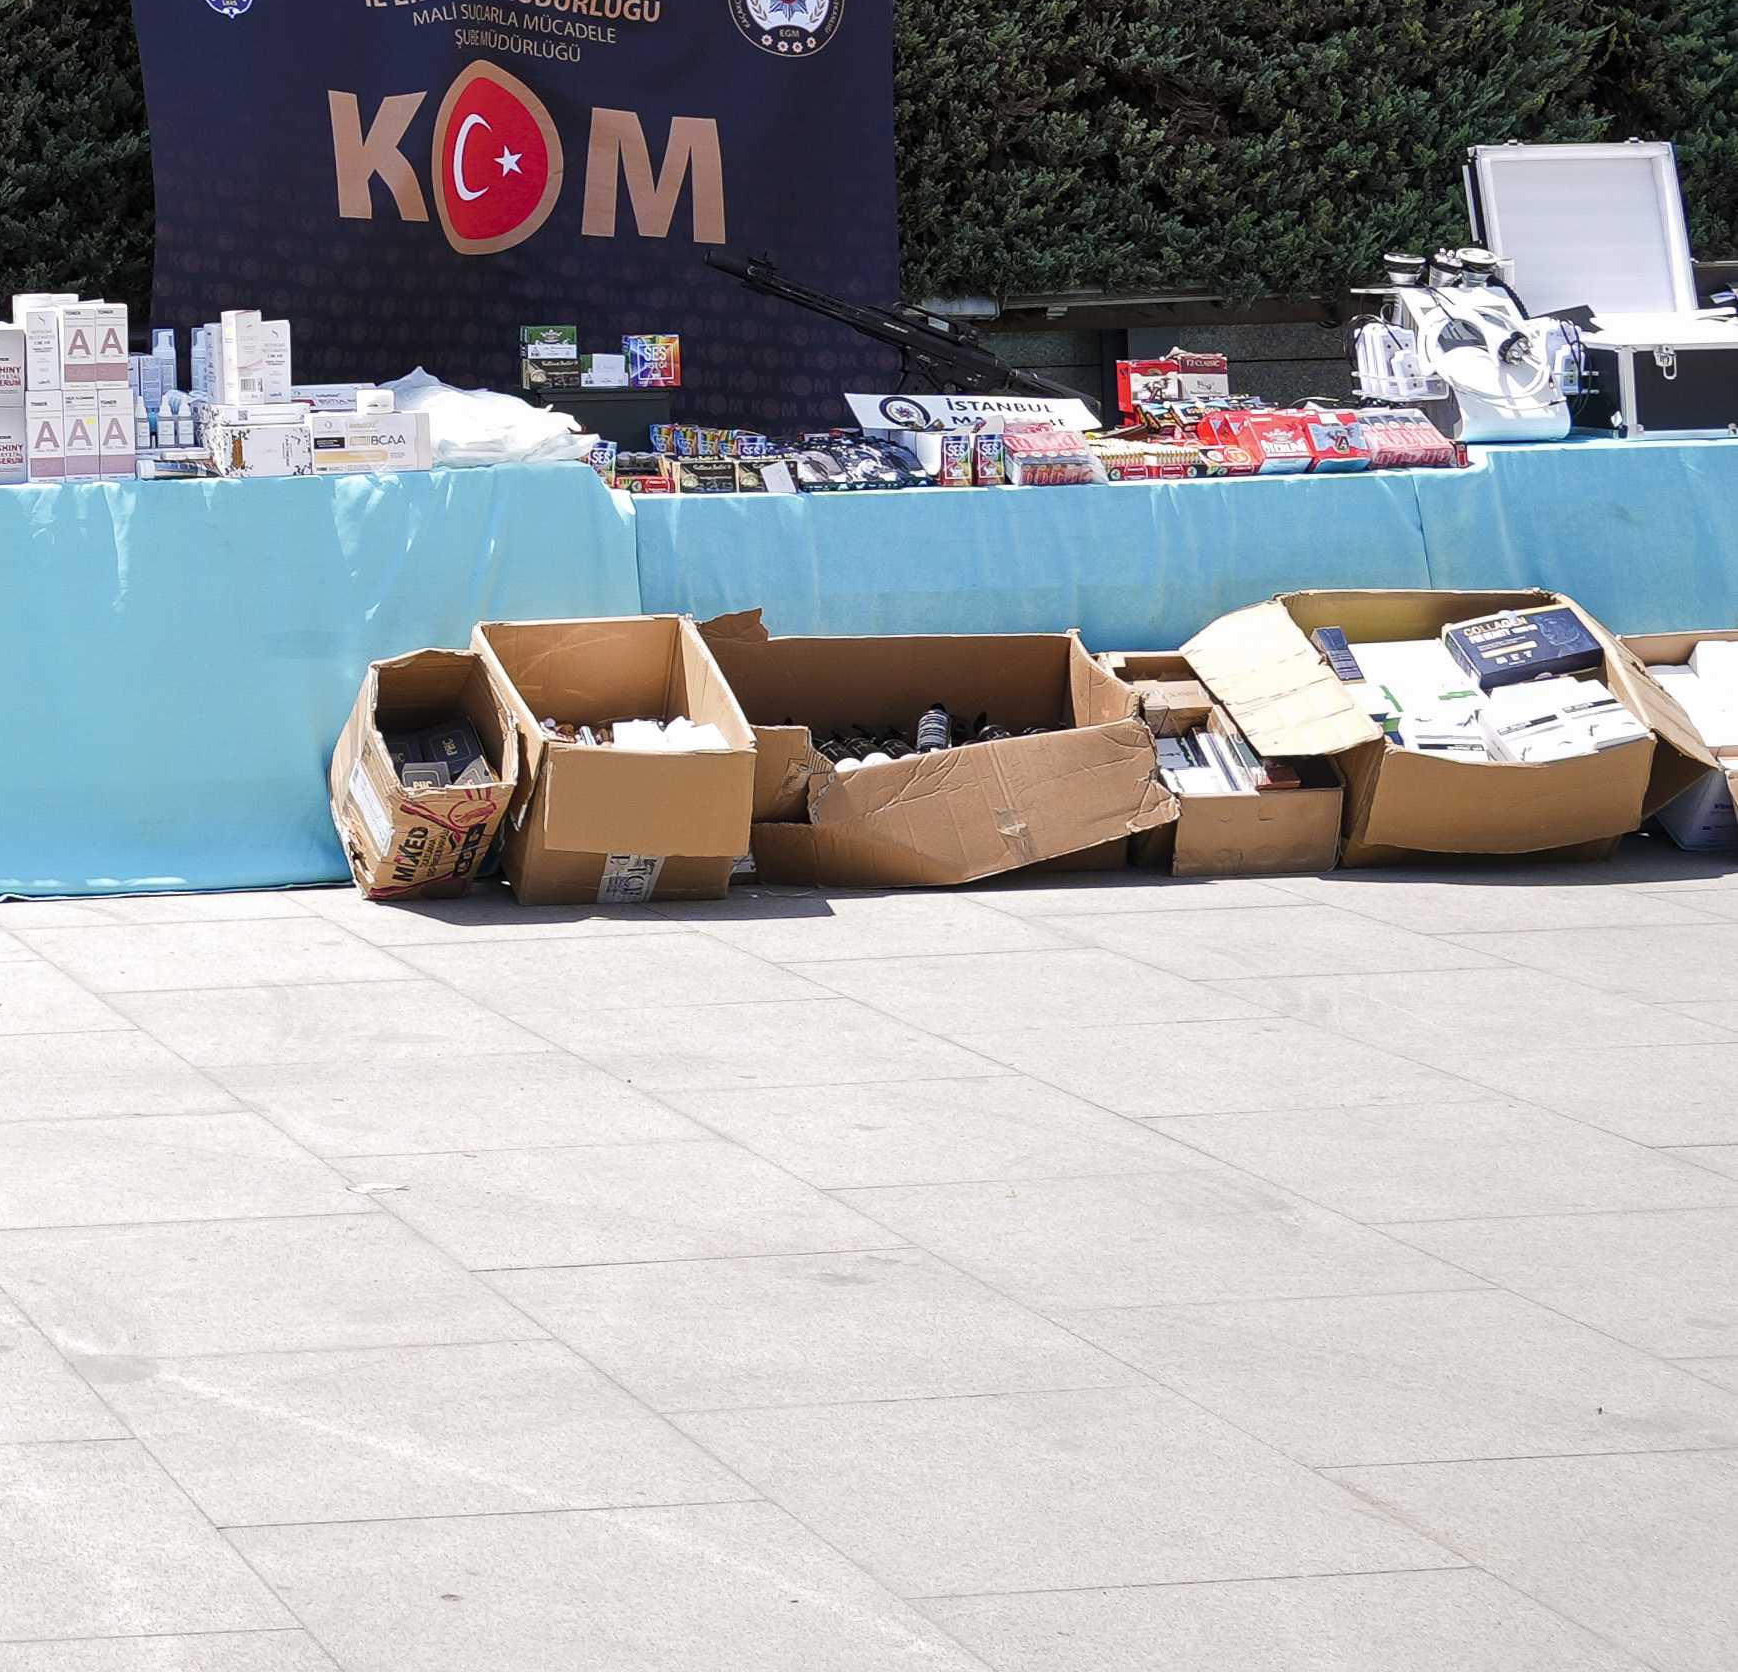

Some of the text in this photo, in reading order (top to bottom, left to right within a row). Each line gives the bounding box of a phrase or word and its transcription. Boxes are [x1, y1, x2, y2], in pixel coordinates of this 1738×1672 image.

[412, 1, 457, 26] MALİ
[522, 13, 617, 44] MÜCADELE
[67, 328, 92, 355] A
[100, 327, 124, 355] A
[644, 346, 667, 361] SES
[946, 397, 1054, 414] İSTANBUL
[34, 421, 60, 449] A
[67, 419, 92, 446] A
[102, 417, 128, 446] A
[371, 435, 406, 445] BCAA
